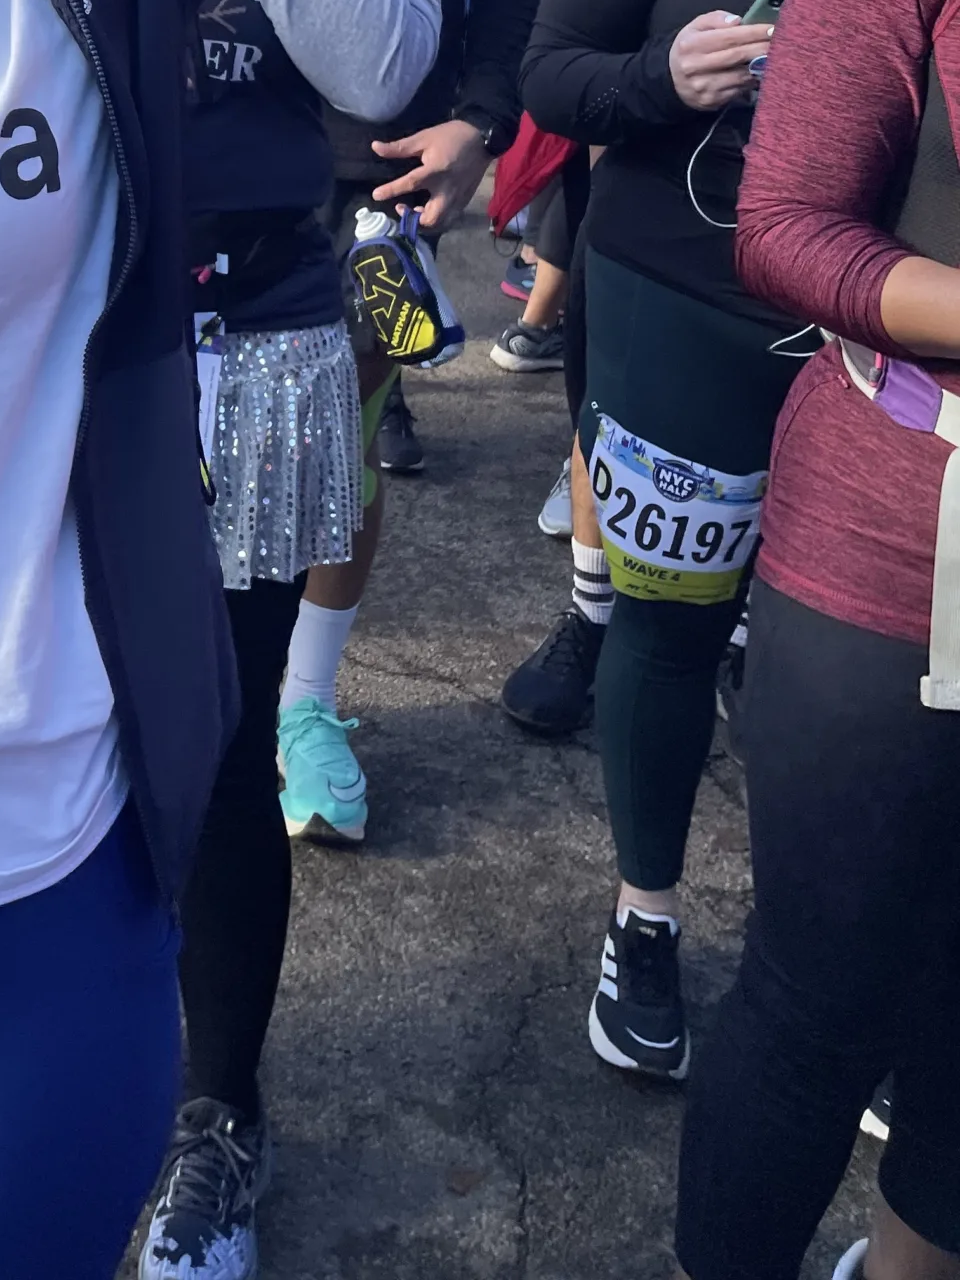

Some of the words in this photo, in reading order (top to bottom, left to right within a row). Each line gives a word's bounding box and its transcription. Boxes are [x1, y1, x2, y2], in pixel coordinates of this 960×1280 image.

[203, 39, 263, 81] ER
[391, 300, 411, 348] NATHAN
[659, 468, 694, 491] NYC
[659, 480, 688, 497] HALF
[623, 556, 667, 580] WAVE
[671, 573, 681, 582] 4
